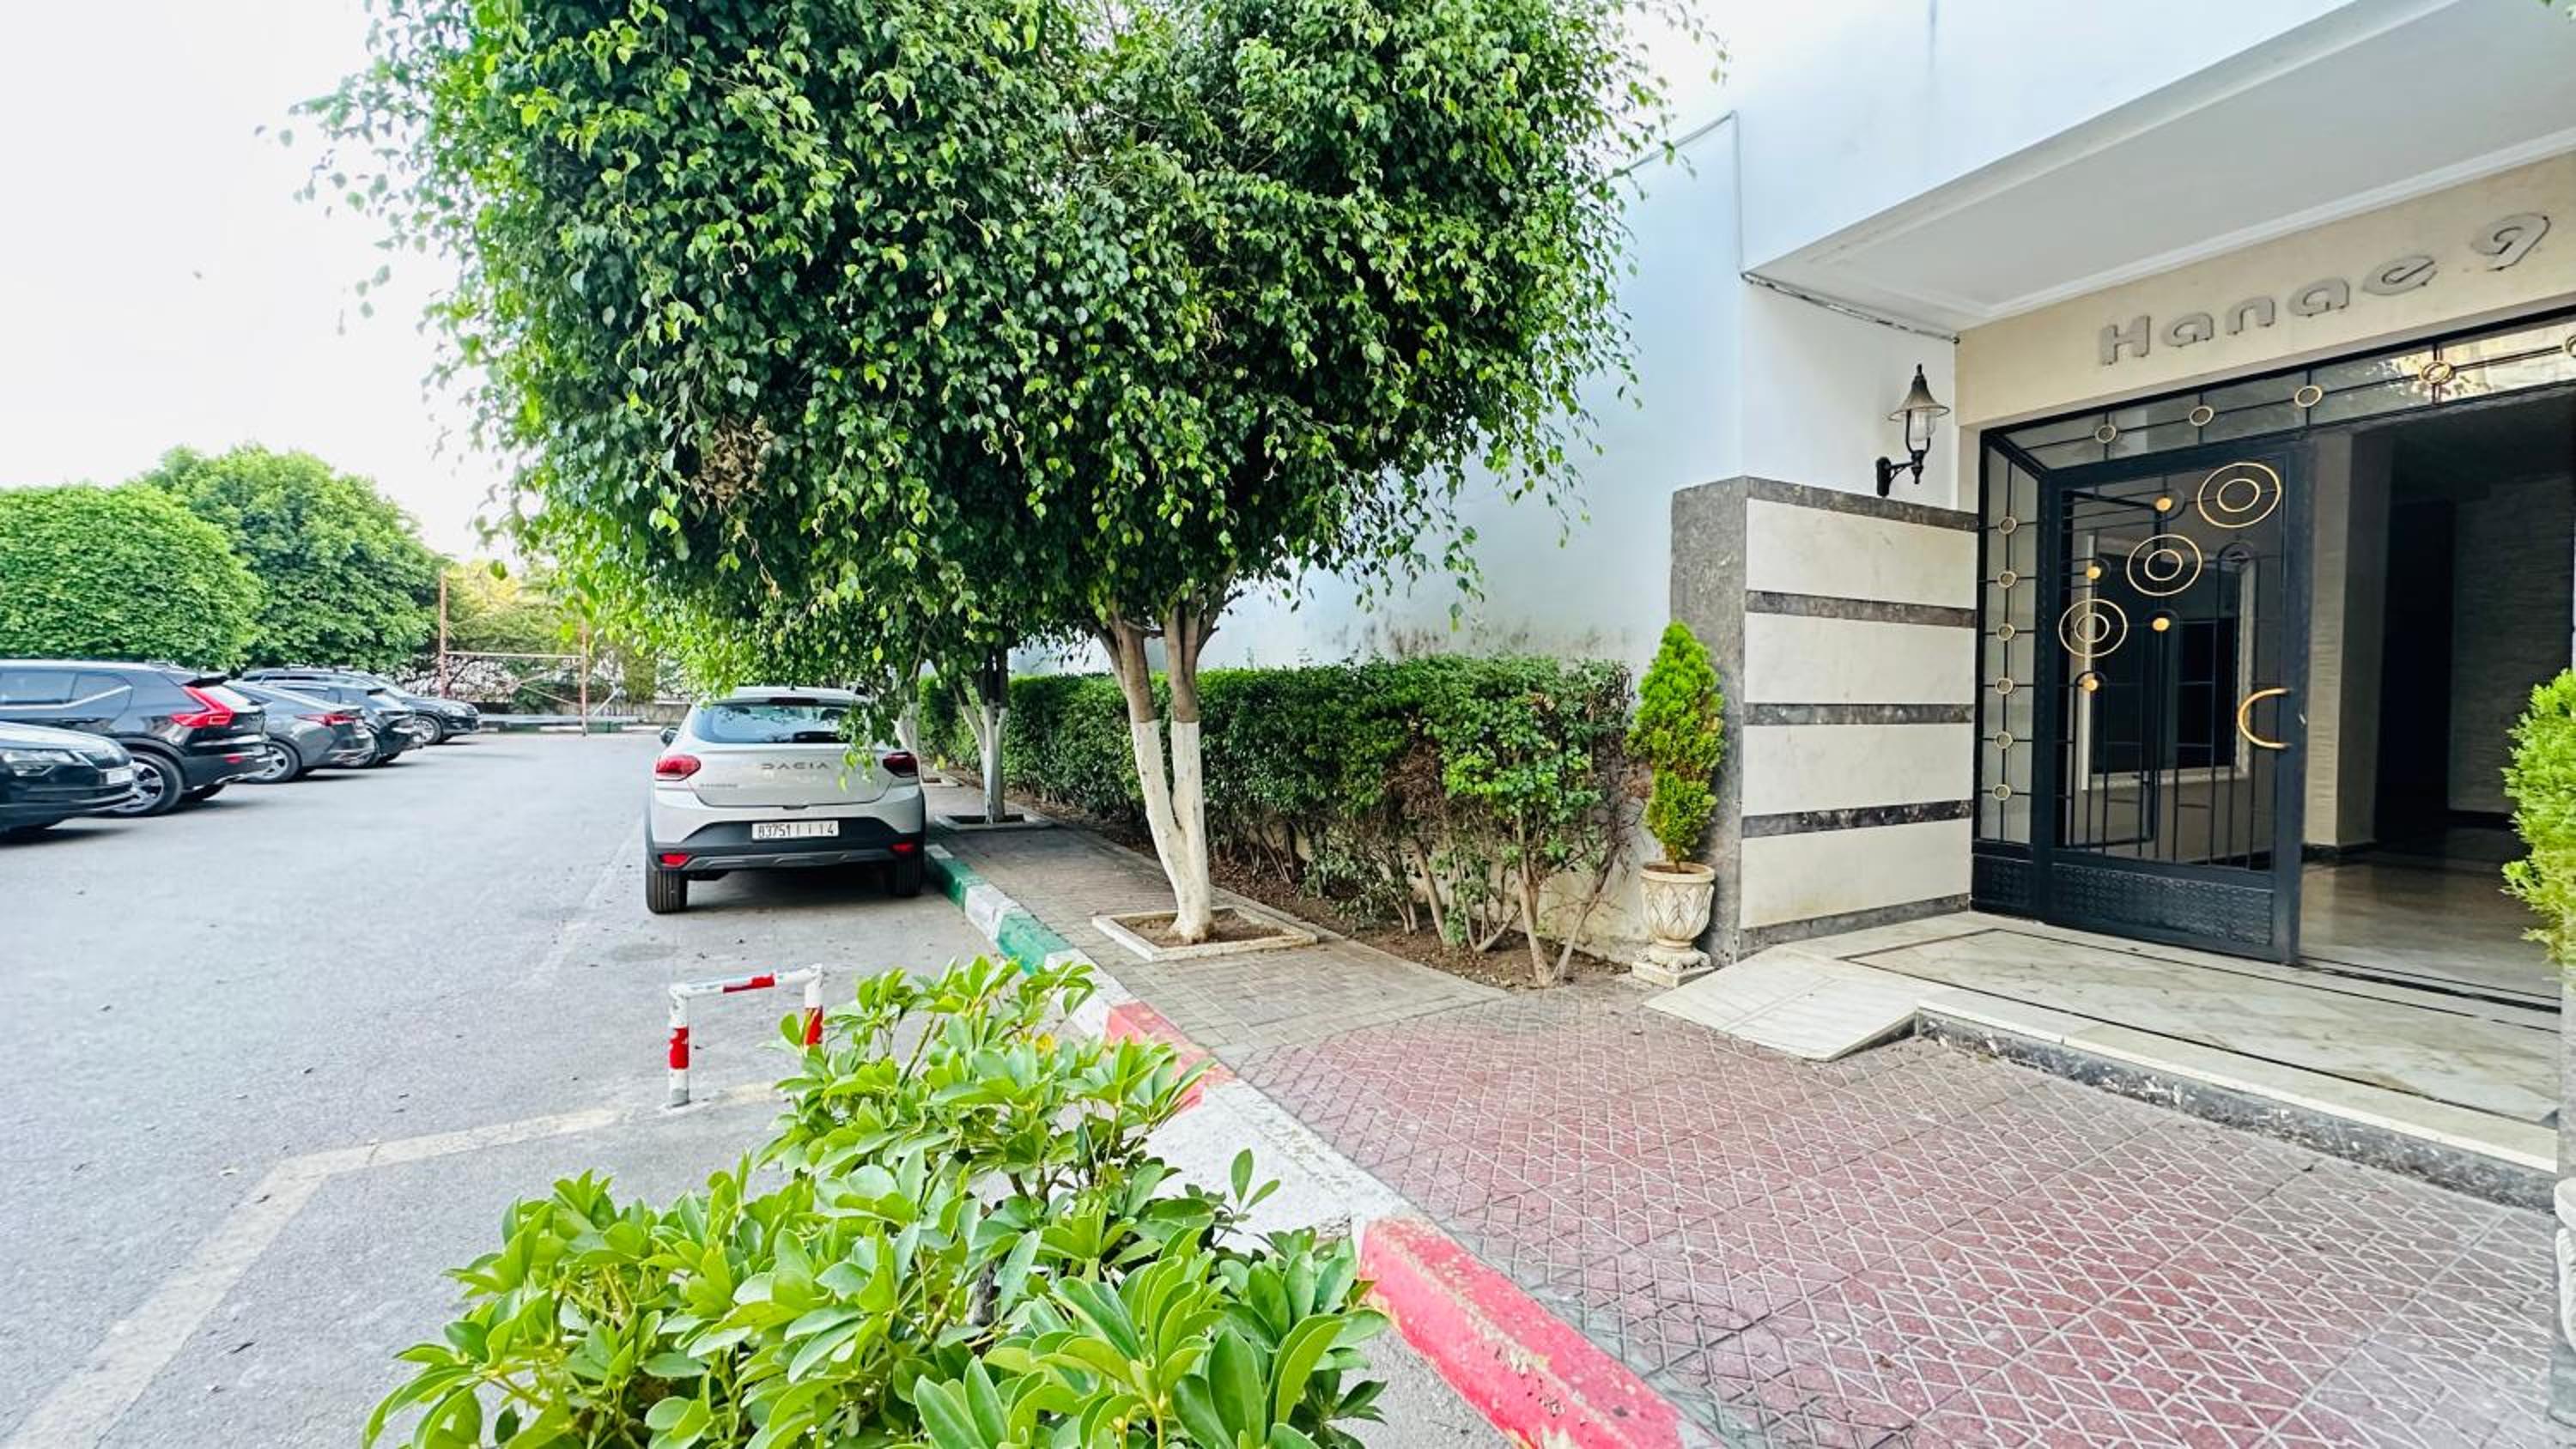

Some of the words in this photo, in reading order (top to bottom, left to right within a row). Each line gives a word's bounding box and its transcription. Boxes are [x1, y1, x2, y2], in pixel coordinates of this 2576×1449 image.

[2099, 254, 2439, 366] Hanae
[2471, 212, 2551, 272] 9
[760, 761, 830, 770] DACIA
